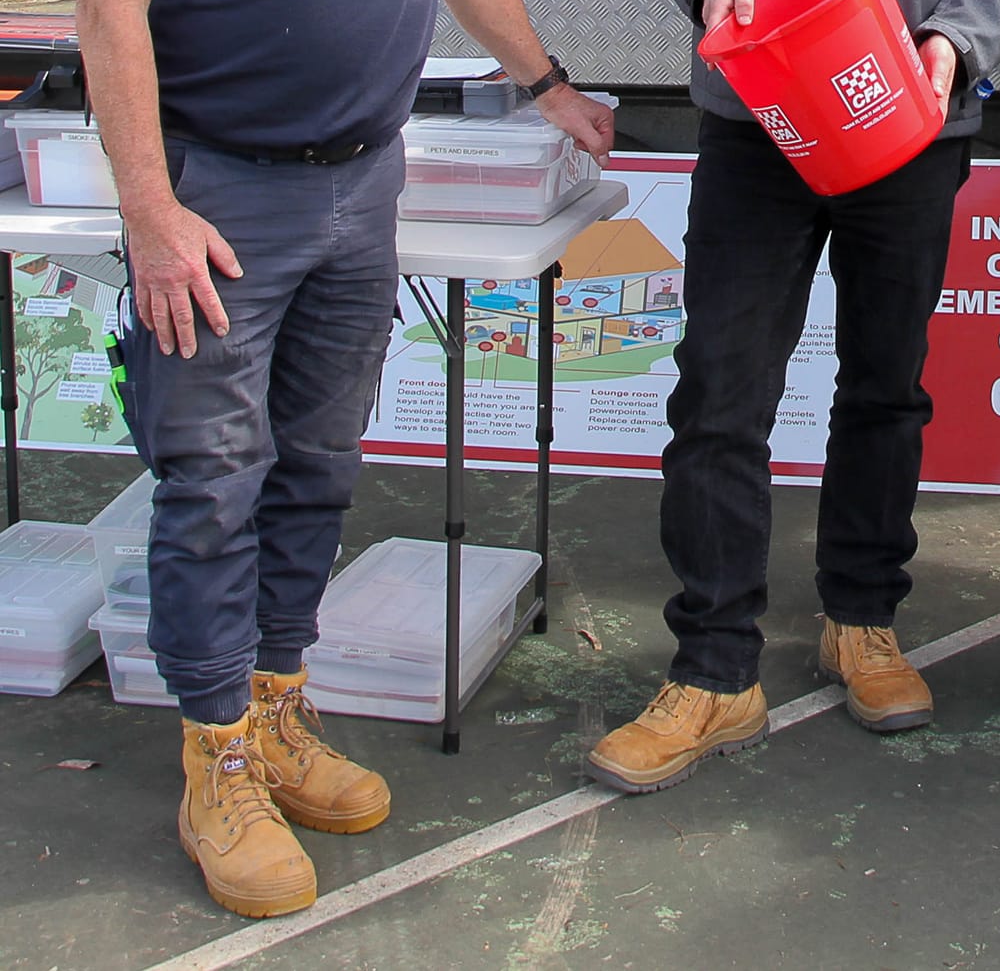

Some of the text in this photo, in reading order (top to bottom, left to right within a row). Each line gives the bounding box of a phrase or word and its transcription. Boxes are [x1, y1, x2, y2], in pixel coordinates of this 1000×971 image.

[852, 81, 885, 109] CFA
[771, 128, 796, 140] CFA
[462, 148, 499, 156] BUSHFIRES
[399, 379, 447, 388] Front doo
[398, 388, 445, 397] Deadlocks
[505, 393, 520, 401] the
[591, 389, 629, 397] Lounge
[396, 398, 418, 406] keys
[420, 398, 434, 406] left
[473, 401, 498, 409] when
[500, 404, 518, 412] you
[590, 398, 658, 408] Don't overload
[396, 407, 433, 416] Develop
[493, 412, 516, 420] your
[589, 407, 649, 416] powerpoints.
[588, 416, 668, 427] Replace damage
[588, 424, 618, 432] power
